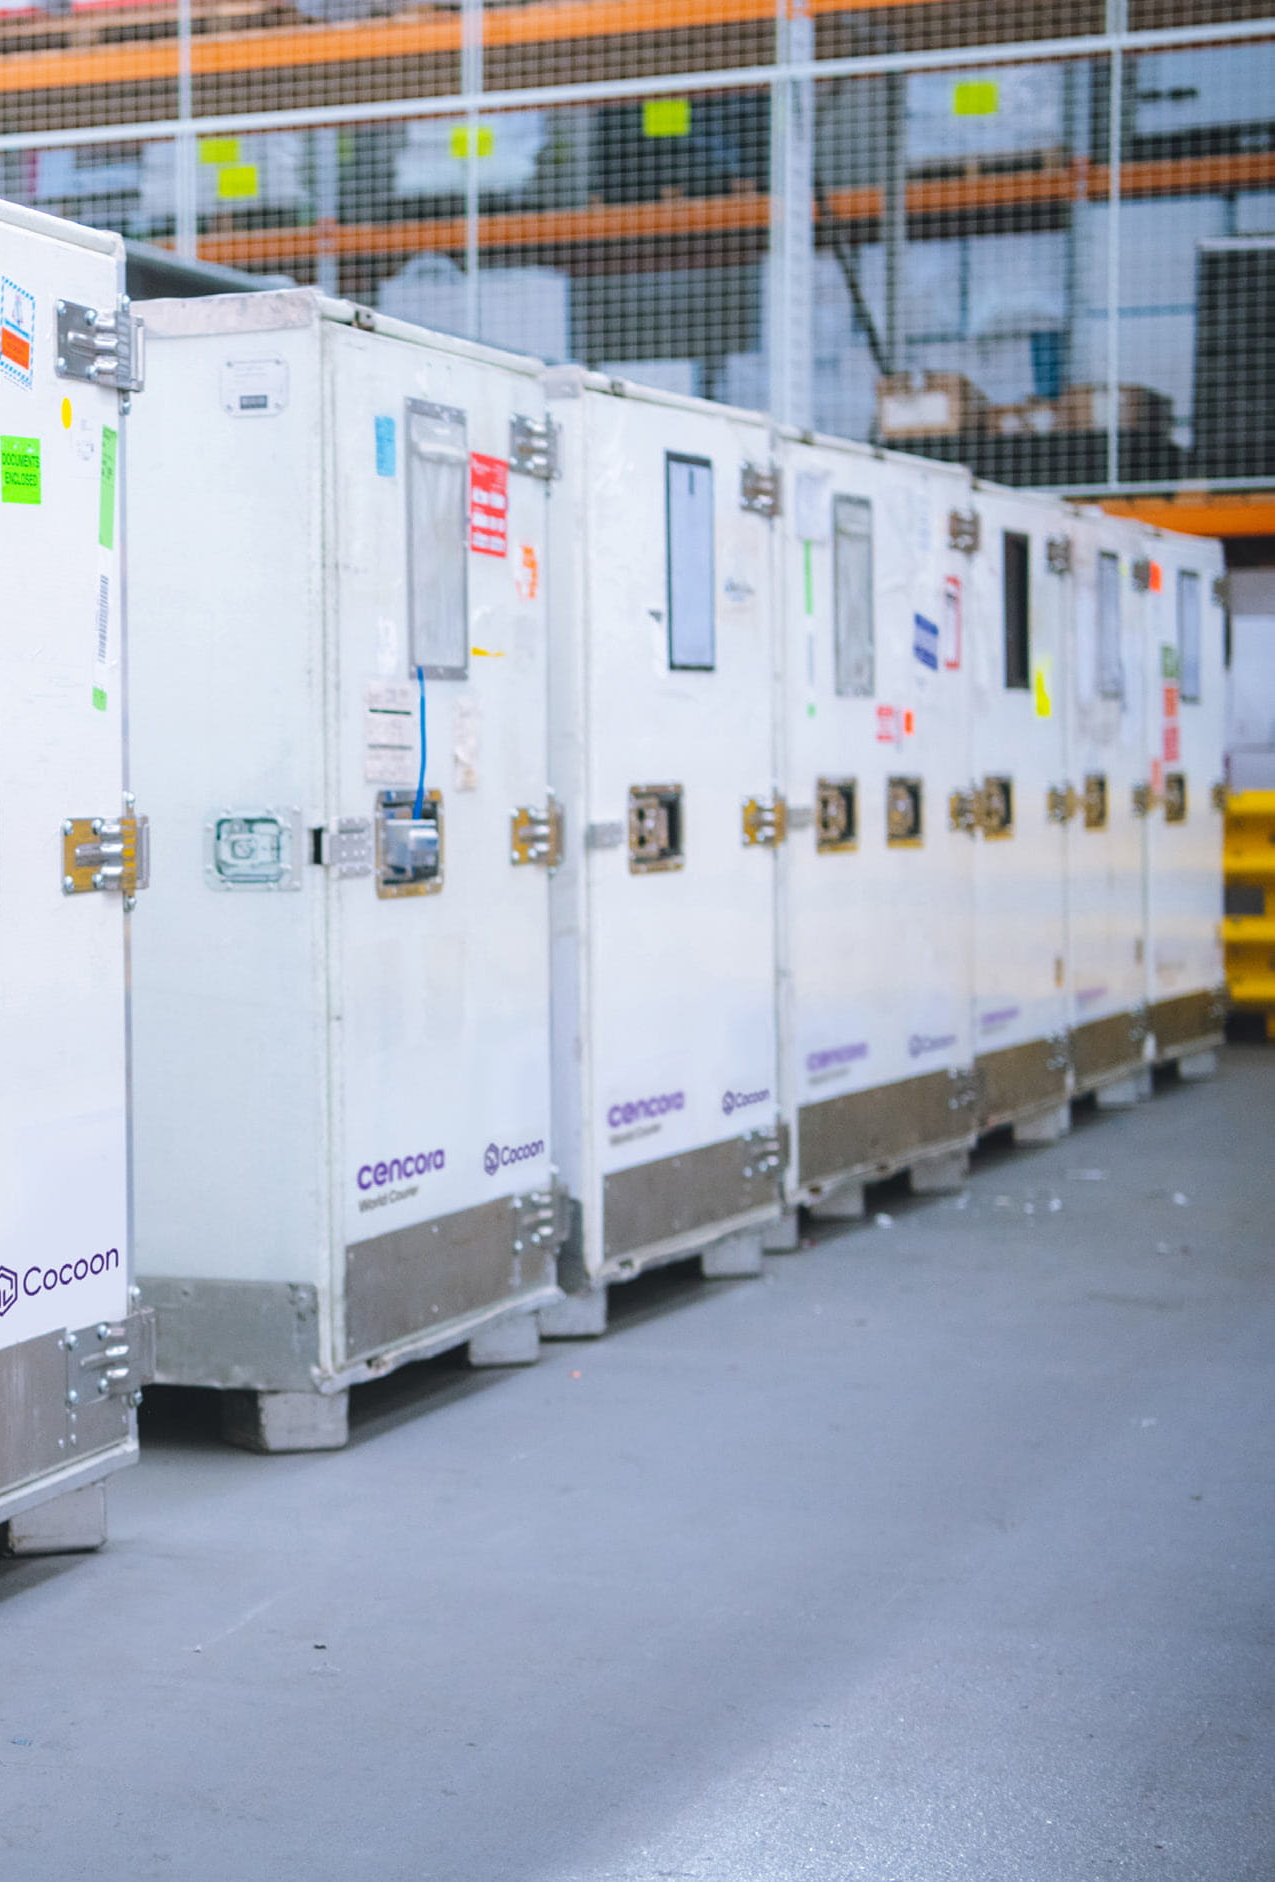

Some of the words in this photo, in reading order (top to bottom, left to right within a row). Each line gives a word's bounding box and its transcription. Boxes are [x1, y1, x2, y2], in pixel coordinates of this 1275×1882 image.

[1, 452, 40, 469] DOCUMENTS
[5, 471, 38, 486] ENCLOSED
[607, 1091, 685, 1128] cencora
[736, 1089, 770, 1108] Cocoon
[501, 1139, 545, 1166] Cocoon
[357, 1149, 445, 1191] cencora
[23, 1248, 119, 1296] Cocoon
